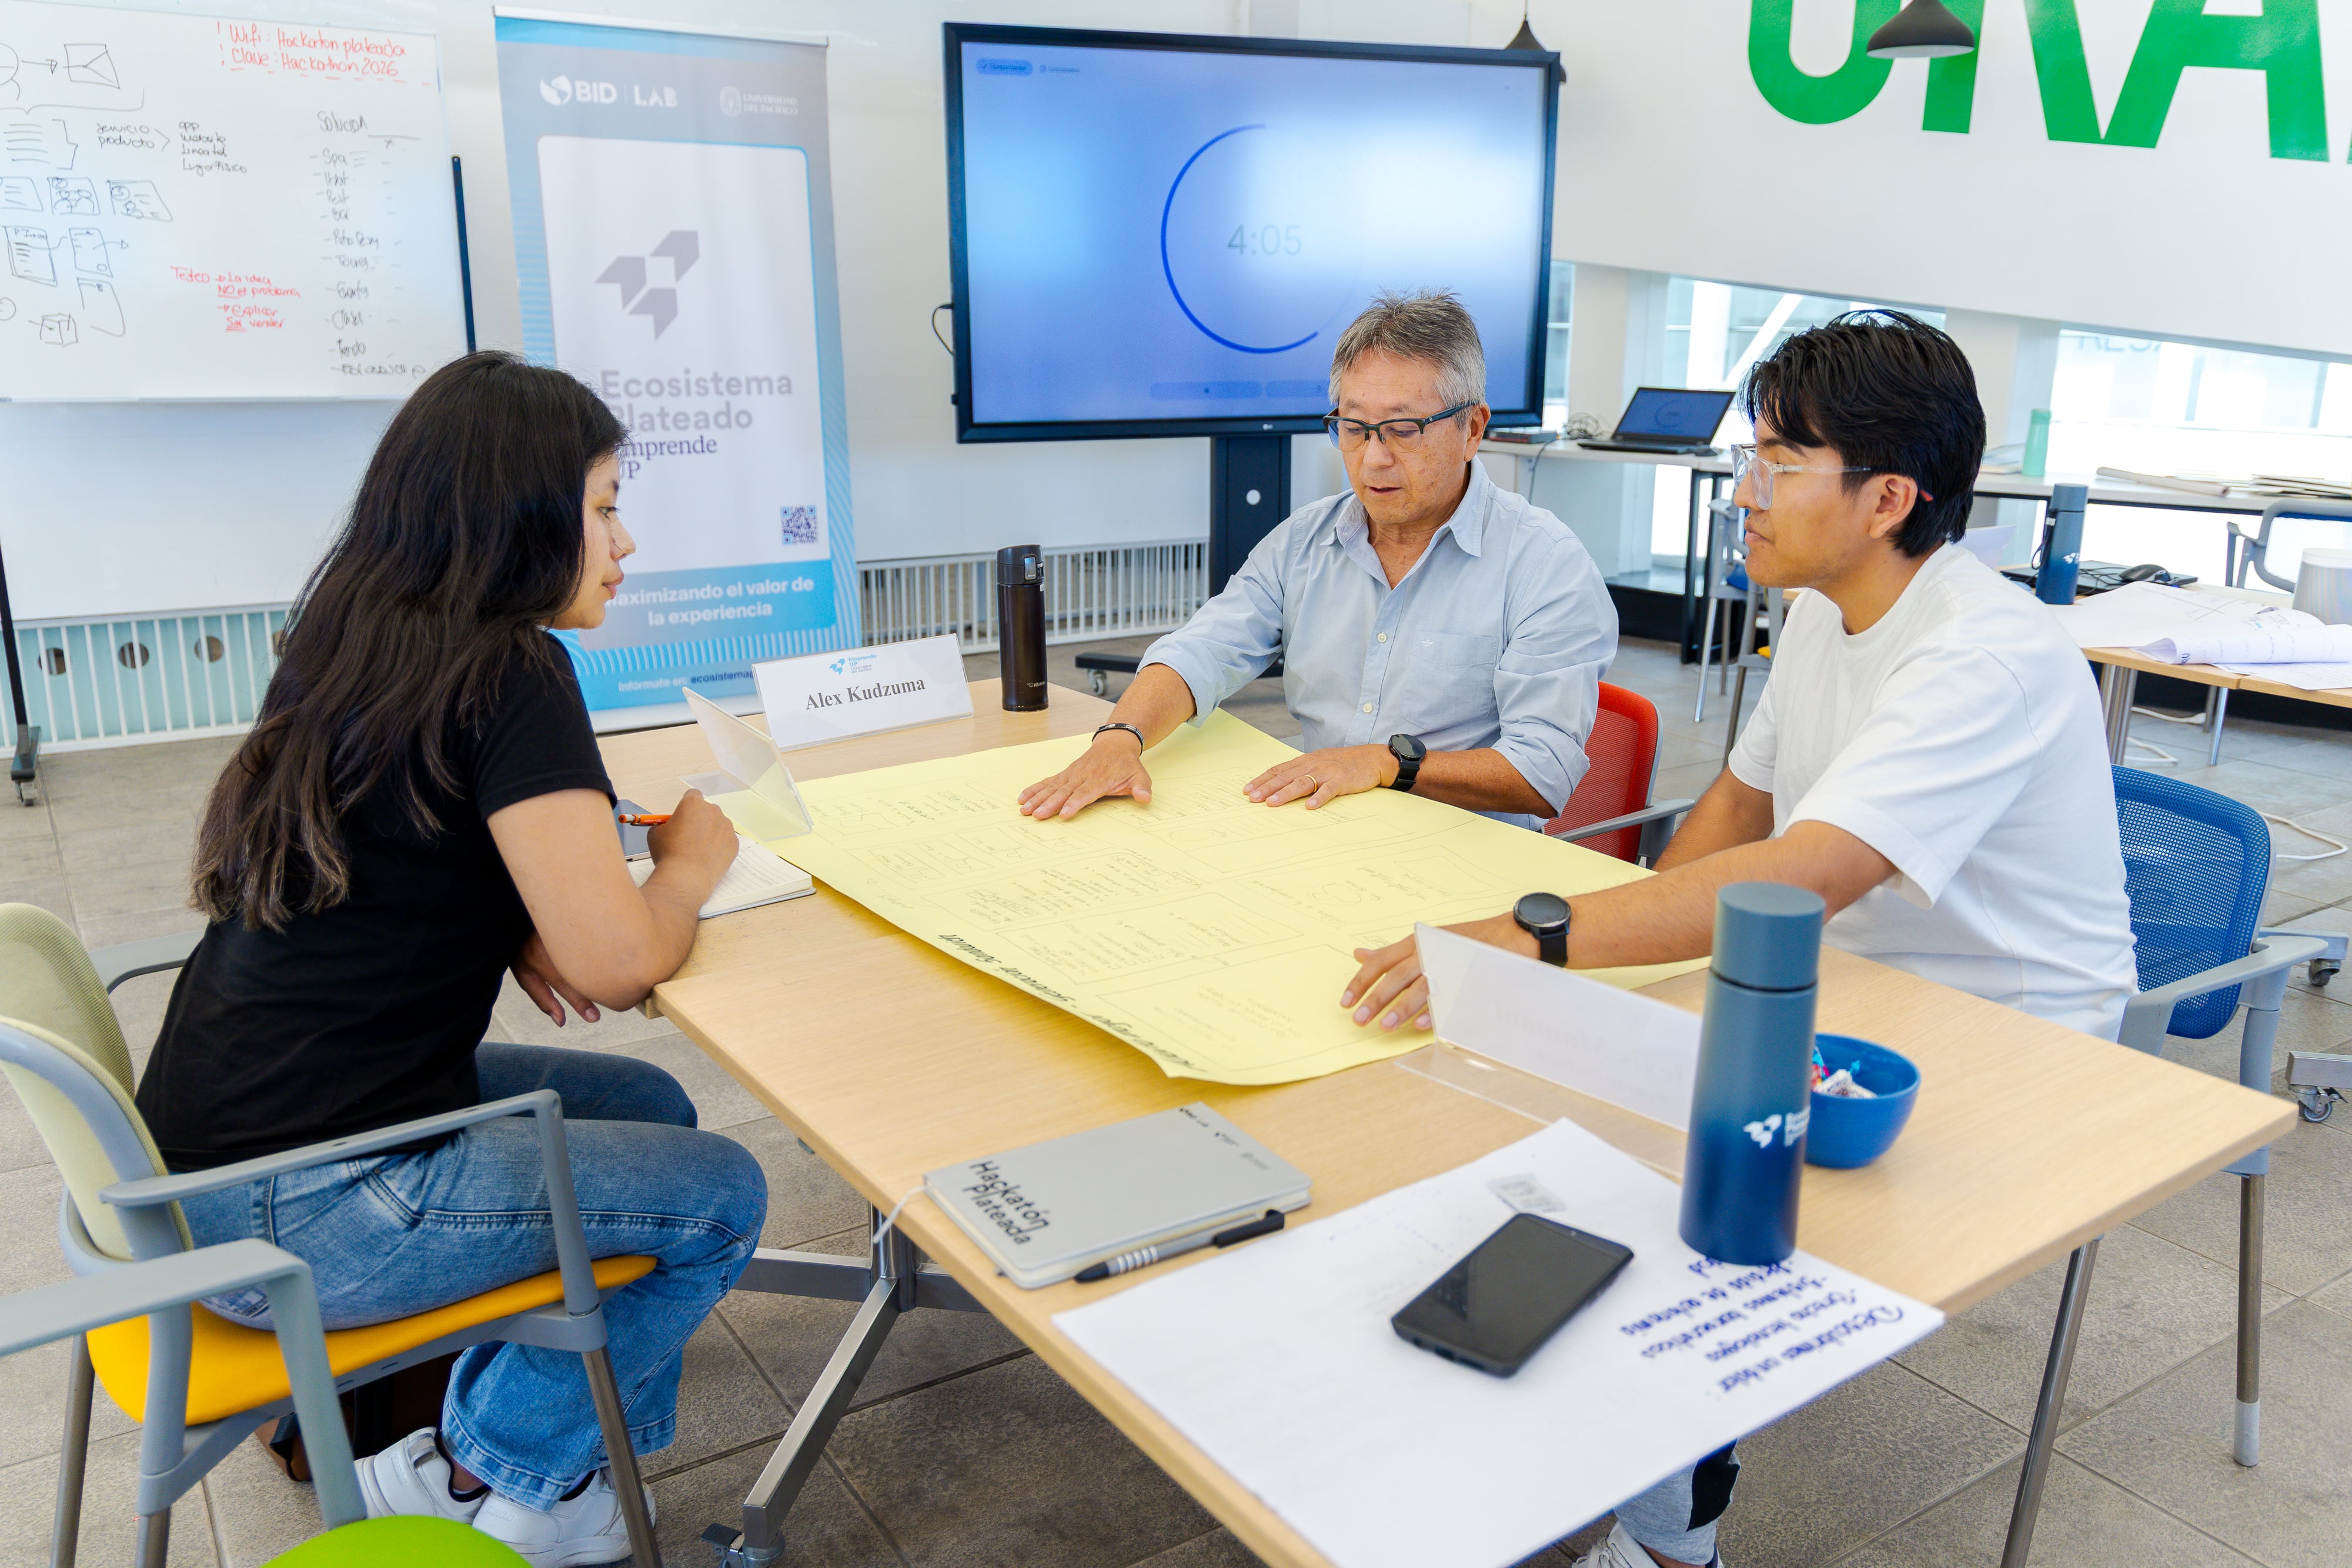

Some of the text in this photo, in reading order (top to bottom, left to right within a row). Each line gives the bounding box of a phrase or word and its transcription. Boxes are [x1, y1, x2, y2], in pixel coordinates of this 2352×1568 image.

[360, 58, 399, 77] 2026
[574, 79, 679, 108] BID LAB
[1227, 223, 1302, 256] 4:05
[600, 368, 793, 400] Ecosistema
[623, 434, 718, 460] mprende
[727, 581, 743, 597] el
[746, 576, 789, 596] valor
[790, 575, 815, 593] de
[648, 600, 774, 627] la experiencia
[848, 653, 877, 663] Emprende
[806, 678, 926, 710] Alex Kudzuma
[962, 1183, 1035, 1246] Plateada
